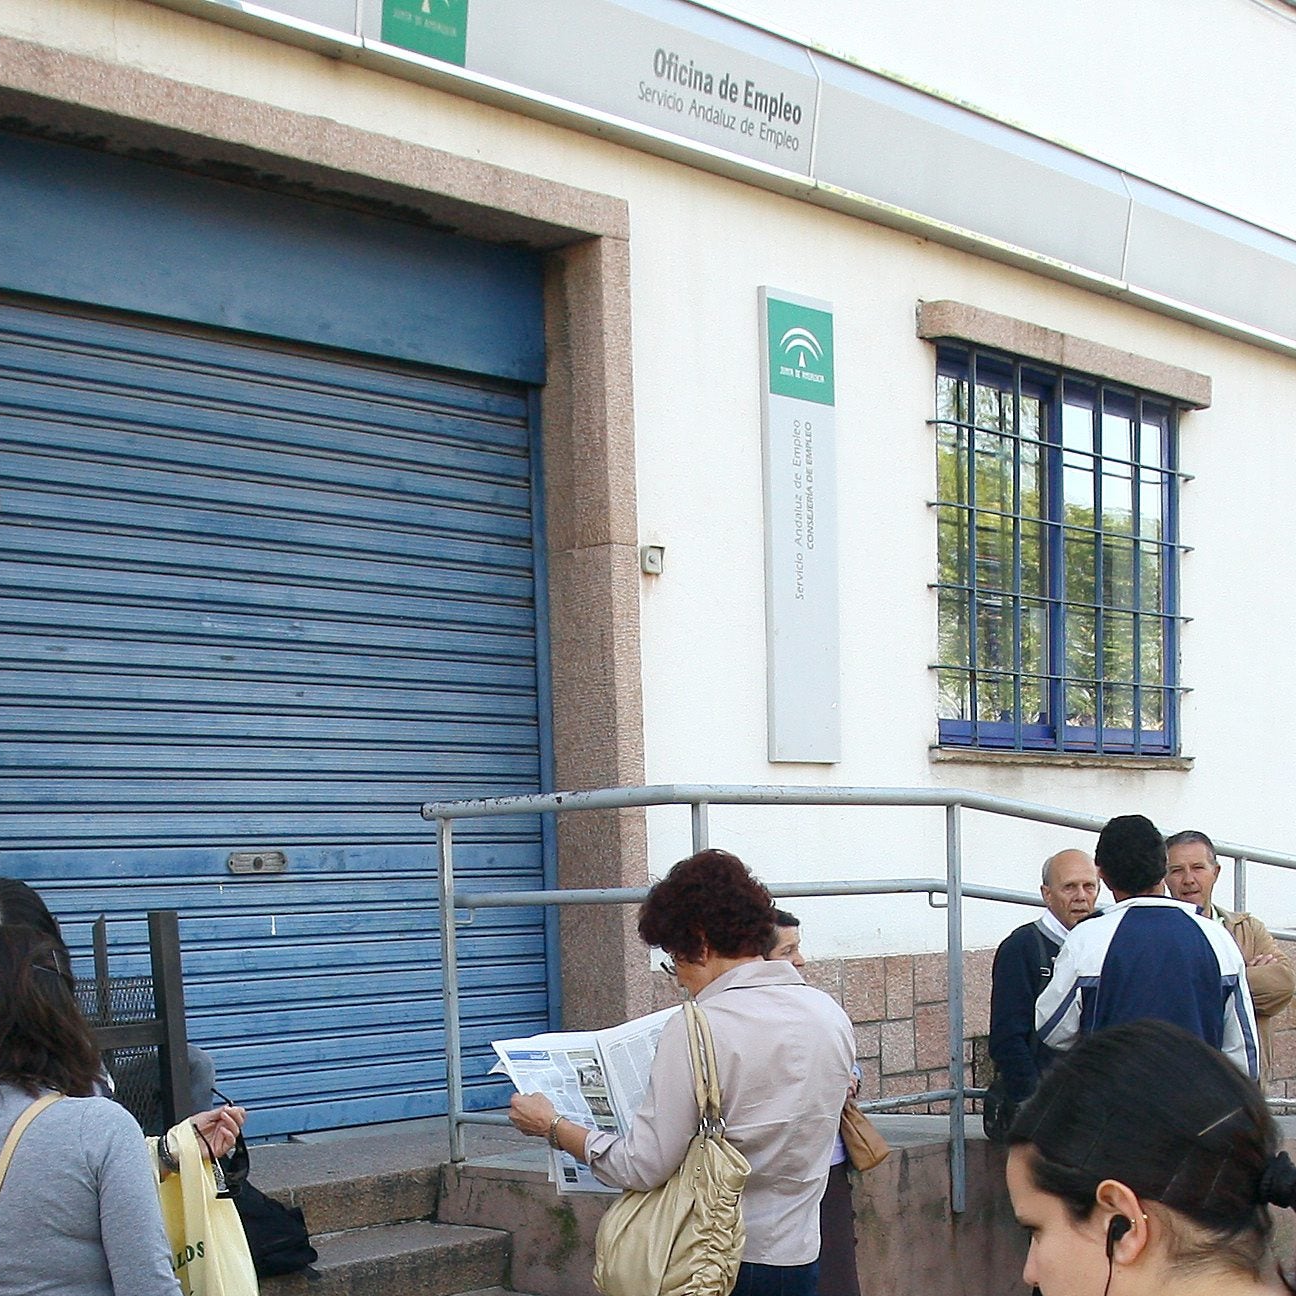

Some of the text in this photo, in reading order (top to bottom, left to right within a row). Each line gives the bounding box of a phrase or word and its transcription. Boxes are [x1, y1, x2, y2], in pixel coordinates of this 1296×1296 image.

[638, 81, 799, 151] Servicio Andaluz de Empleo
[654, 48, 802, 125] Oficina de Empleo
[804, 421, 812, 465] EMPLEO
[806, 467, 813, 482] DE
[792, 420, 804, 600] Servicio Andaluz de Empleo
